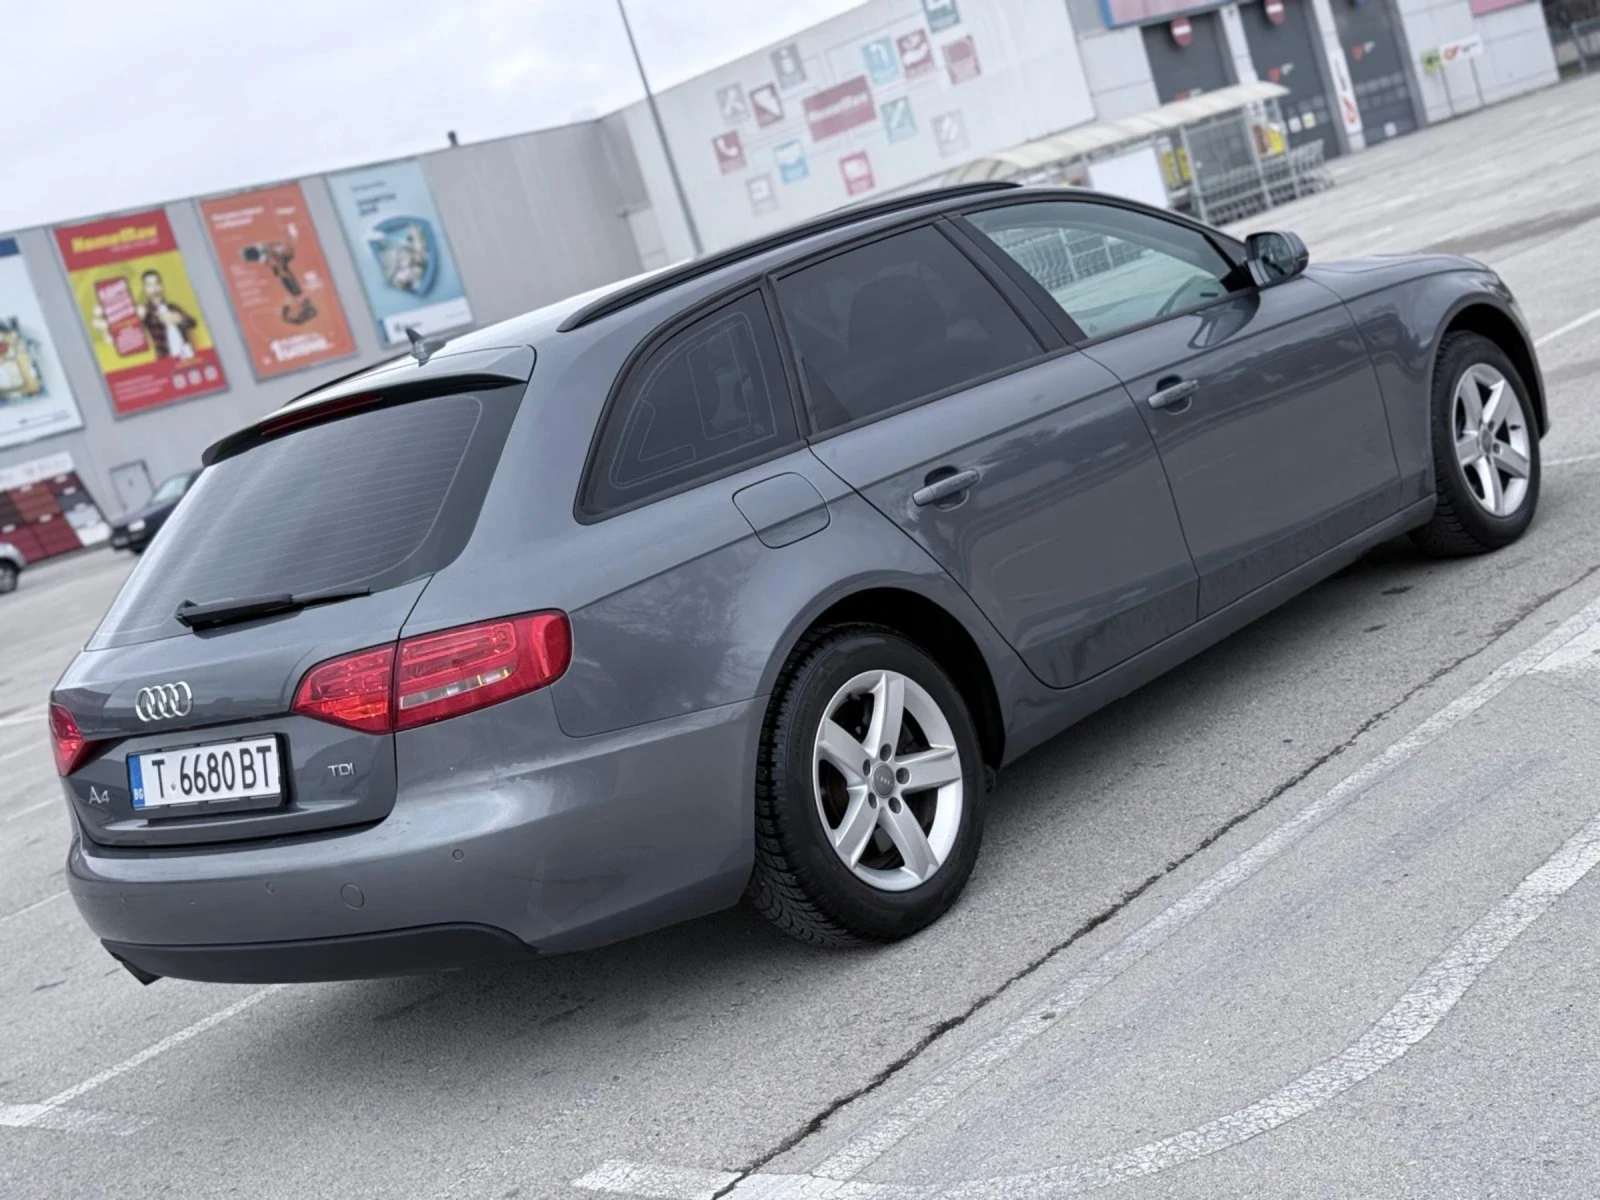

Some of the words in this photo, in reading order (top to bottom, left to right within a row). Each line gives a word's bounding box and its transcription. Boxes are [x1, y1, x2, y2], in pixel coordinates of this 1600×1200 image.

[327, 762, 355, 777] TDI
[89, 785, 110, 804] A4
[133, 788, 144, 801] BG
